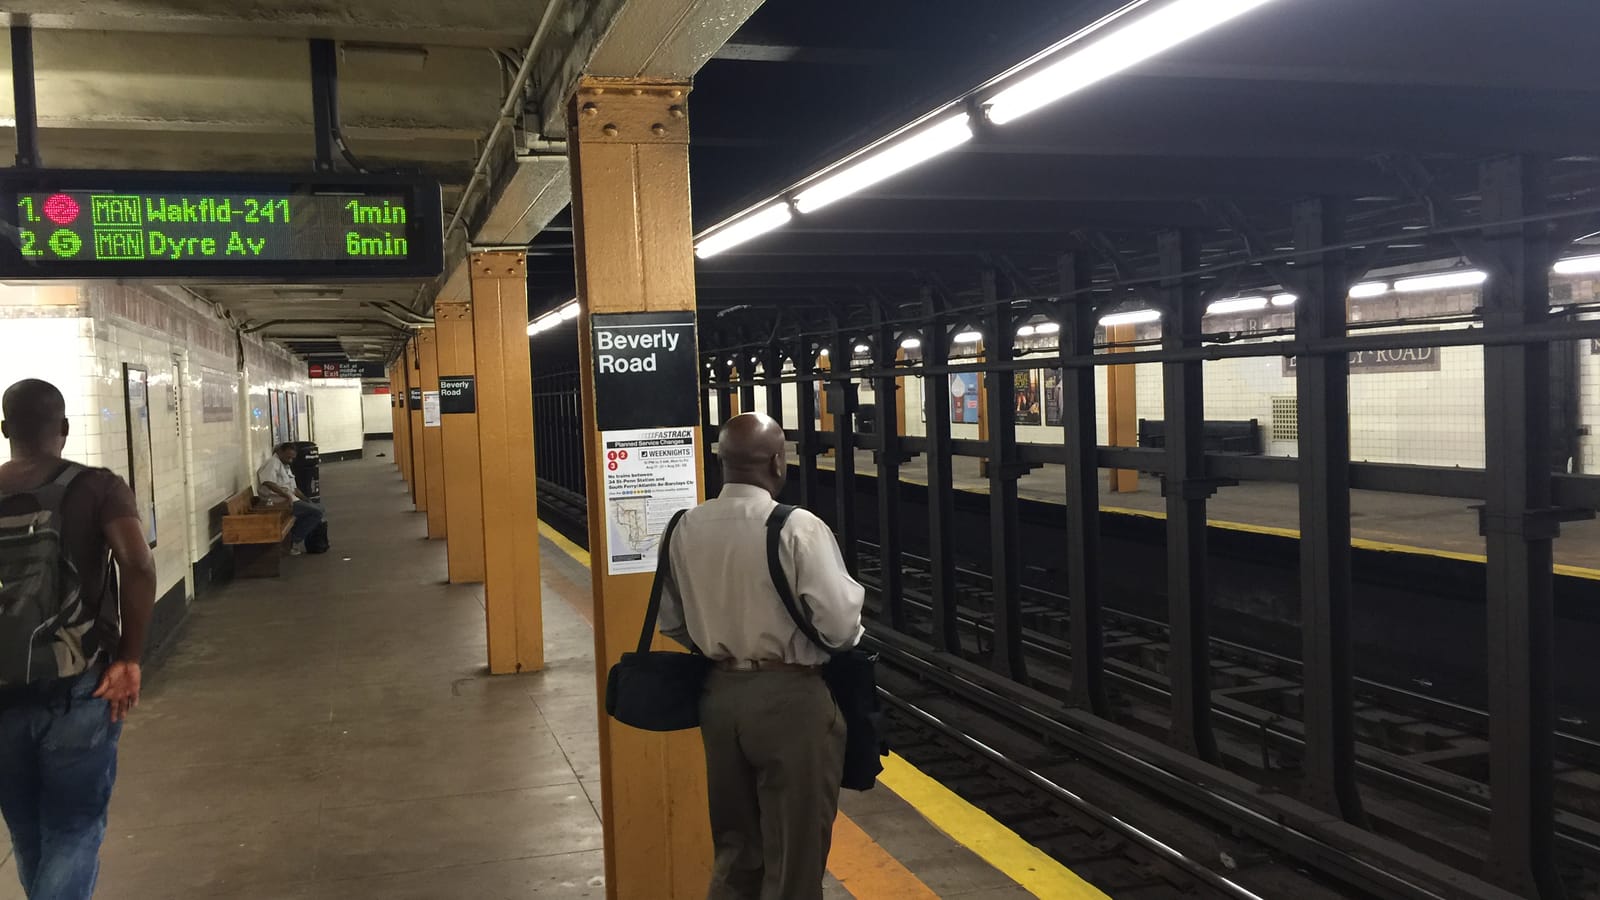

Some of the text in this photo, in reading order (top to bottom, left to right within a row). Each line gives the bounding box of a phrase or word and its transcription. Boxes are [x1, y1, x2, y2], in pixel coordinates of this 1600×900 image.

[17, 196, 41, 222] 1.
[96, 199, 137, 222] MAN
[146, 197, 290, 223] Wakfld-241
[344, 199, 406, 224] 1min
[20, 231, 44, 256] 2.
[99, 232, 140, 255] MAN
[148, 230, 216, 260] Dyre
[225, 230, 266, 256] Av
[345, 231, 408, 256] 6min
[597, 329, 680, 352] Beverly
[598, 352, 657, 374] Road
[1377, 347, 1432, 363] ROAD
[323, 363, 335, 371] No
[440, 381, 469, 389] Beverly
[654, 430, 692, 439] FASTRACK
[648, 448, 690, 457] WEEKNIGHTS
